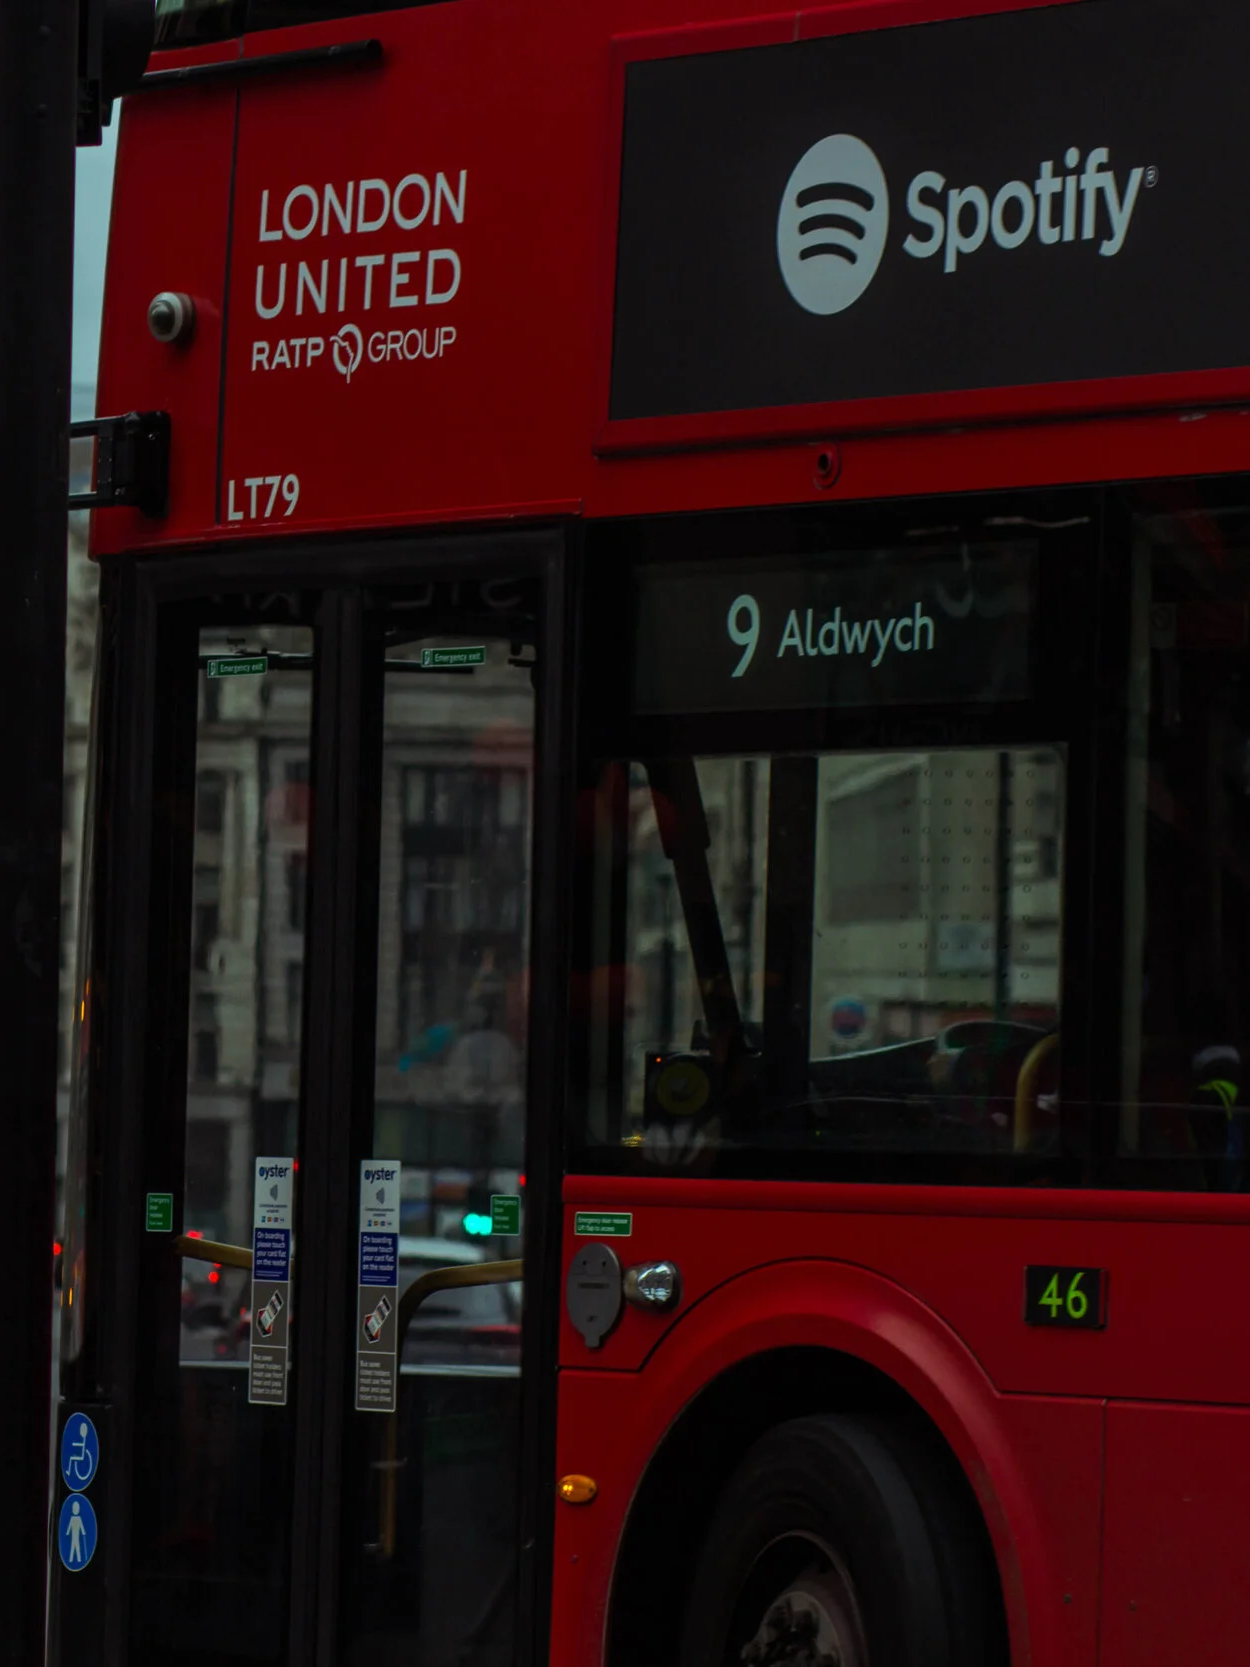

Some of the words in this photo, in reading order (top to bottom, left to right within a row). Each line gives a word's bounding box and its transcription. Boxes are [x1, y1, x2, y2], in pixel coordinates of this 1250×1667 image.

[258, 169, 468, 243] LONDON
[902, 146, 1146, 274] Spotify
[254, 248, 462, 320] UNITED
[251, 336, 326, 372] RATP
[367, 325, 457, 364] GROUP
[227, 473, 301, 522] LT79
[726, 593, 761, 678] 9
[776, 601, 935, 668] Aldwych
[259, 1164, 288, 1180] oyster
[365, 1168, 395, 1184] oyster
[1037, 1271, 1089, 1320] 46
